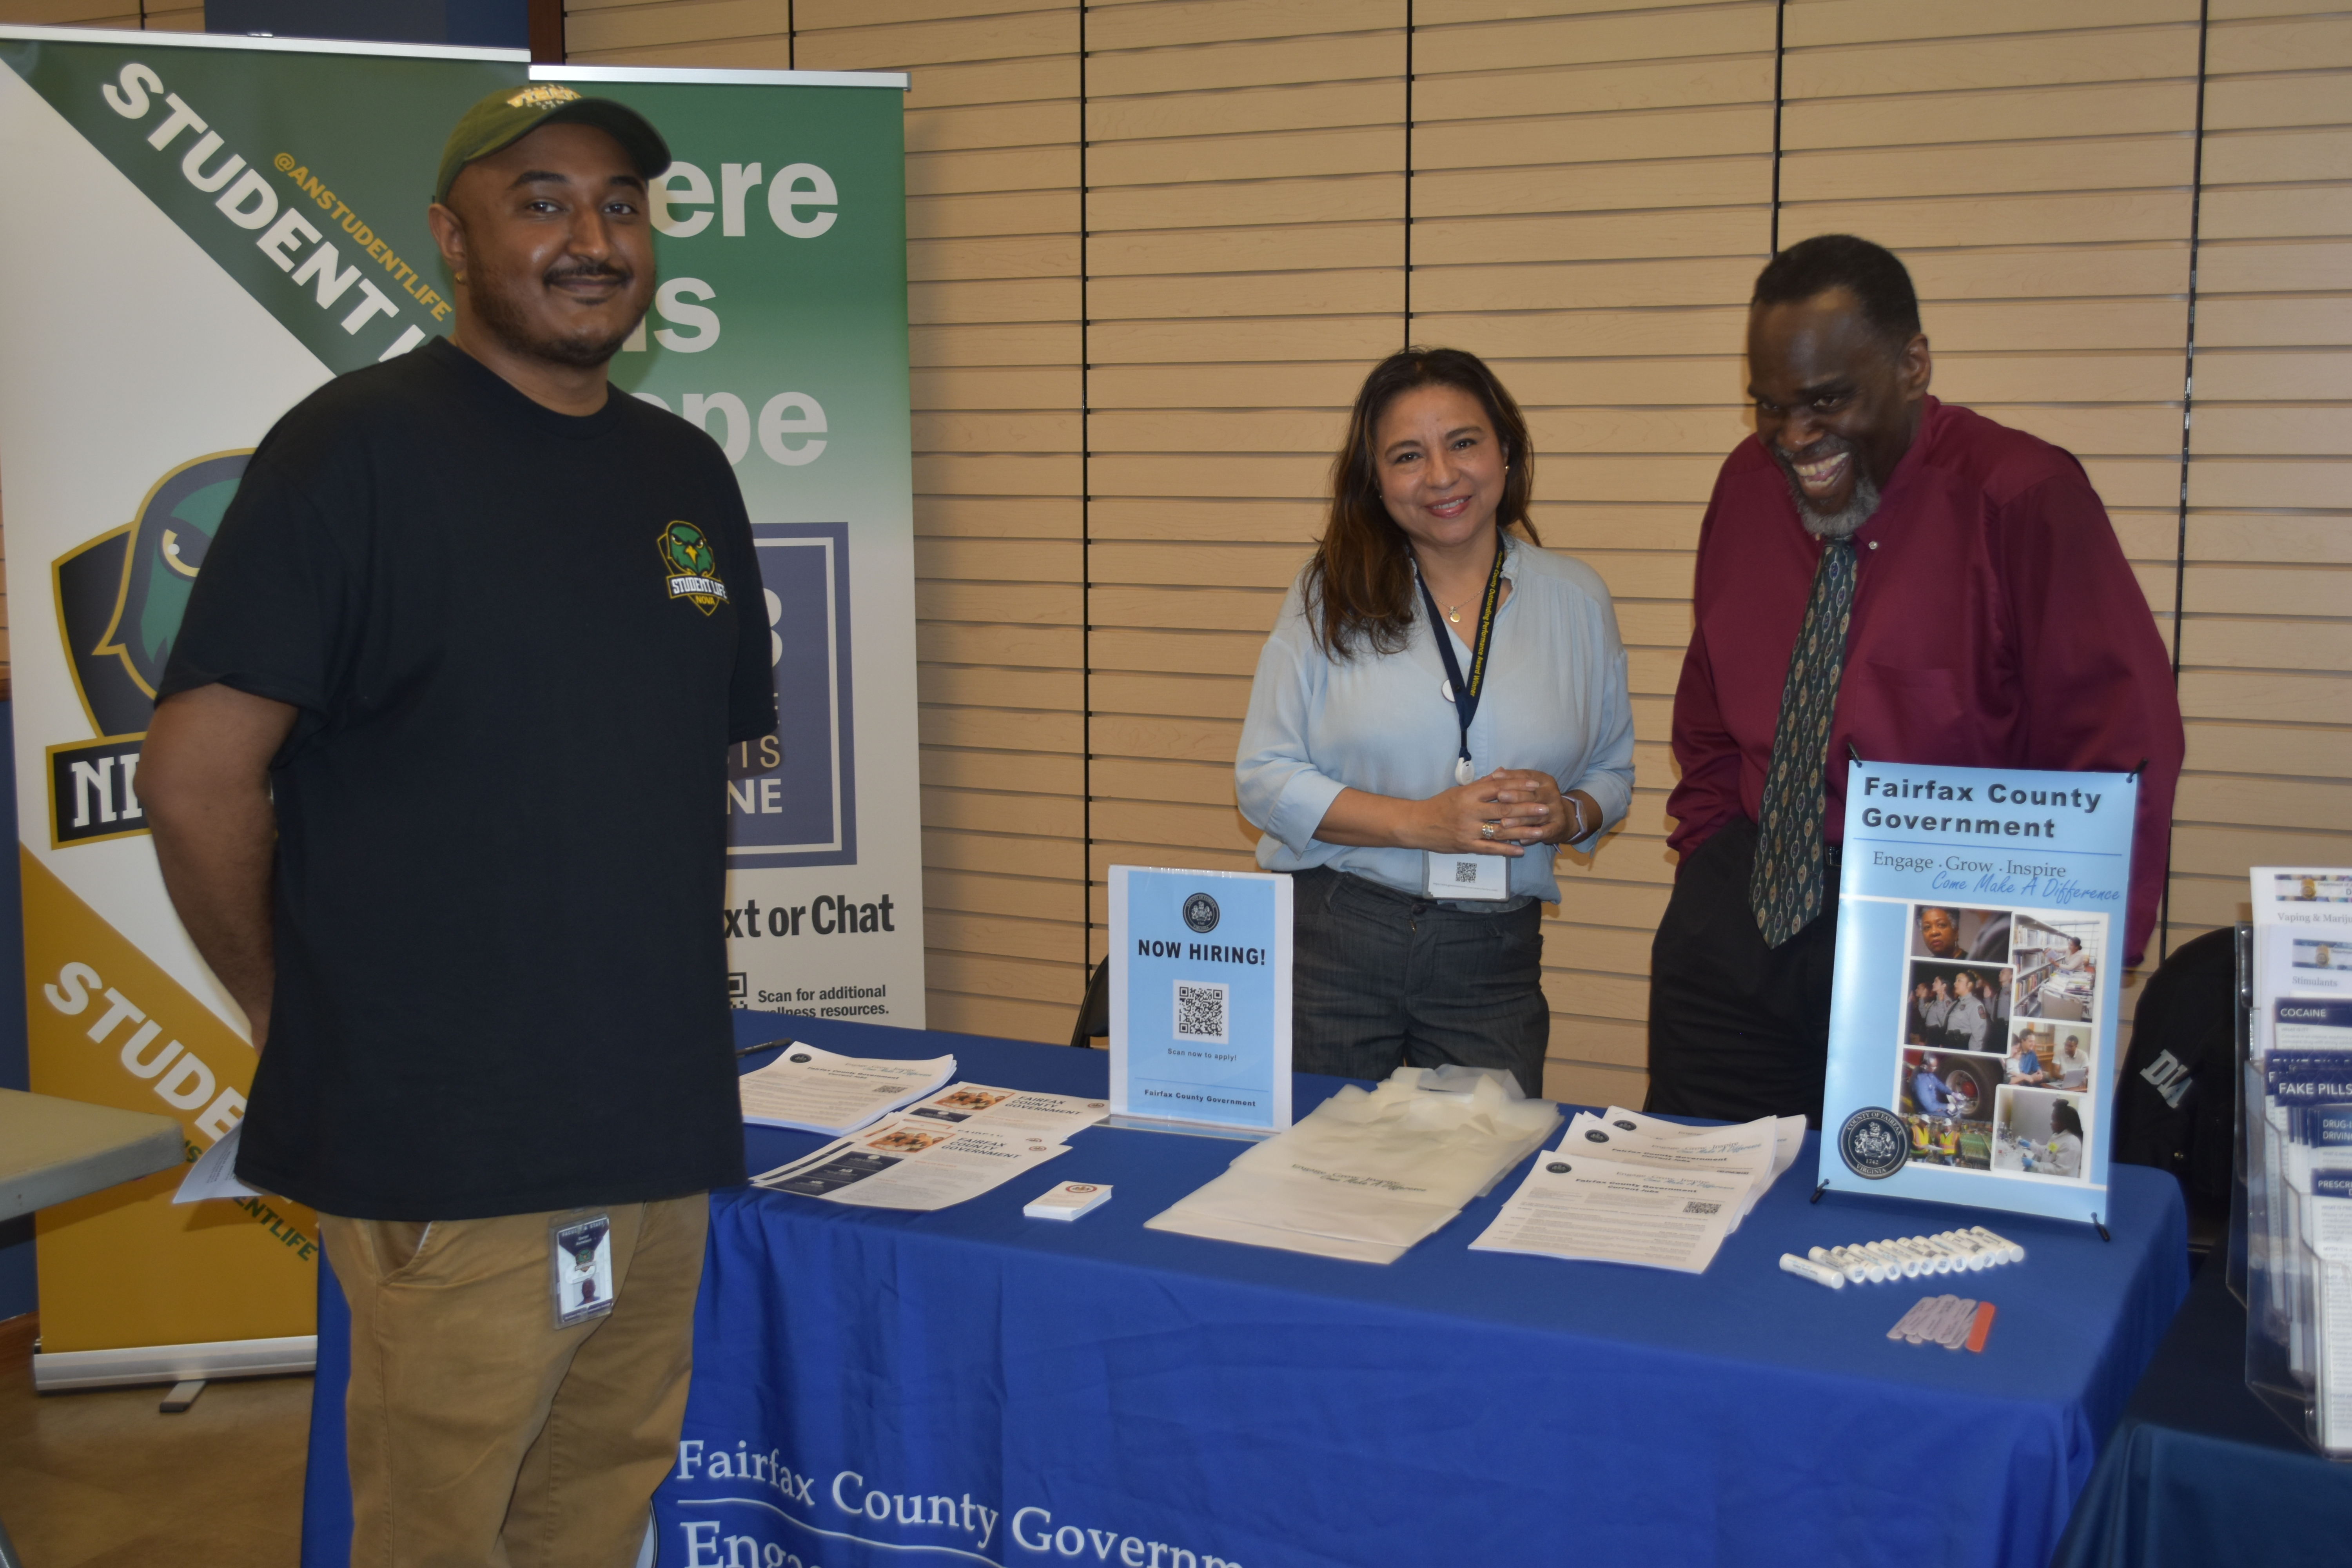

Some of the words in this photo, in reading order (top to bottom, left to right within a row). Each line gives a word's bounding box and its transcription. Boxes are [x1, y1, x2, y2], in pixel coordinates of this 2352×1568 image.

[103, 63, 400, 336] STUDENT
[274, 152, 452, 321] @ANSTUDENTLIFE
[627, 391, 828, 466] pe
[671, 577, 712, 594] STUDENT
[1490, 569, 1499, 588] County
[695, 595, 715, 605] NOVA
[1483, 588, 1495, 621] Outstanding
[1478, 621, 1490, 655] Performance
[1474, 656, 1483, 674] Award
[1470, 675, 1480, 697] Winner
[1864, 777, 1973, 802] Fairfax
[1988, 783, 2102, 813] County
[1862, 808, 2055, 838] Government
[1873, 851, 1934, 873] Engage
[1945, 857, 1993, 873] Grow
[2006, 860, 2066, 880] Inspire
[1932, 871, 1967, 891] Come
[1973, 873, 2014, 894] Make
[2021, 877, 2037, 897] A
[2043, 879, 2120, 905] Difference
[768, 906, 806, 937] or
[811, 894, 895, 935] Chat
[2278, 912, 2310, 923] Vaping
[1138, 939, 1181, 958] NOW
[1189, 943, 1265, 965] HIRING!
[2292, 975, 2337, 987] Stimulants
[758, 989, 792, 1003] Scan
[796, 987, 815, 1001] for
[819, 984, 886, 1000] additional
[820, 1004, 889, 1018] resources.
[2280, 1008, 2326, 1017] COCAINE
[44, 961, 249, 1142] STUDE
[1144, 1089, 1172, 1098] Fairfax
[1176, 1092, 1203, 1102] County
[1207, 1095, 1256, 1107] Government
[2279, 1083, 2314, 1094] FAKE
[2318, 1083, 2352, 1095] PILLS
[1005, 1103, 1083, 1115] GOVERNMENT
[1012, 1100, 1059, 1108] COUNTY
[1018, 1096, 1066, 1105] FAIRFAX
[1847, 1112, 1870, 1130] COUNTY
[1881, 1112, 1903, 1136] FAIRFAX
[2323, 1119, 2352, 1128] DRUG-I
[949, 1141, 998, 1151] COUNTY
[958, 1137, 1007, 1147] FAIRFAX
[941, 1145, 1022, 1158] GOVERNMENT
[1857, 1163, 1887, 1174] VIRGINIA
[1643, 1184, 1697, 1193] Government
[676, 1439, 815, 1505] Fairfax
[832, 1470, 999, 1548] County
[680, 1521, 823, 1568] Eng
